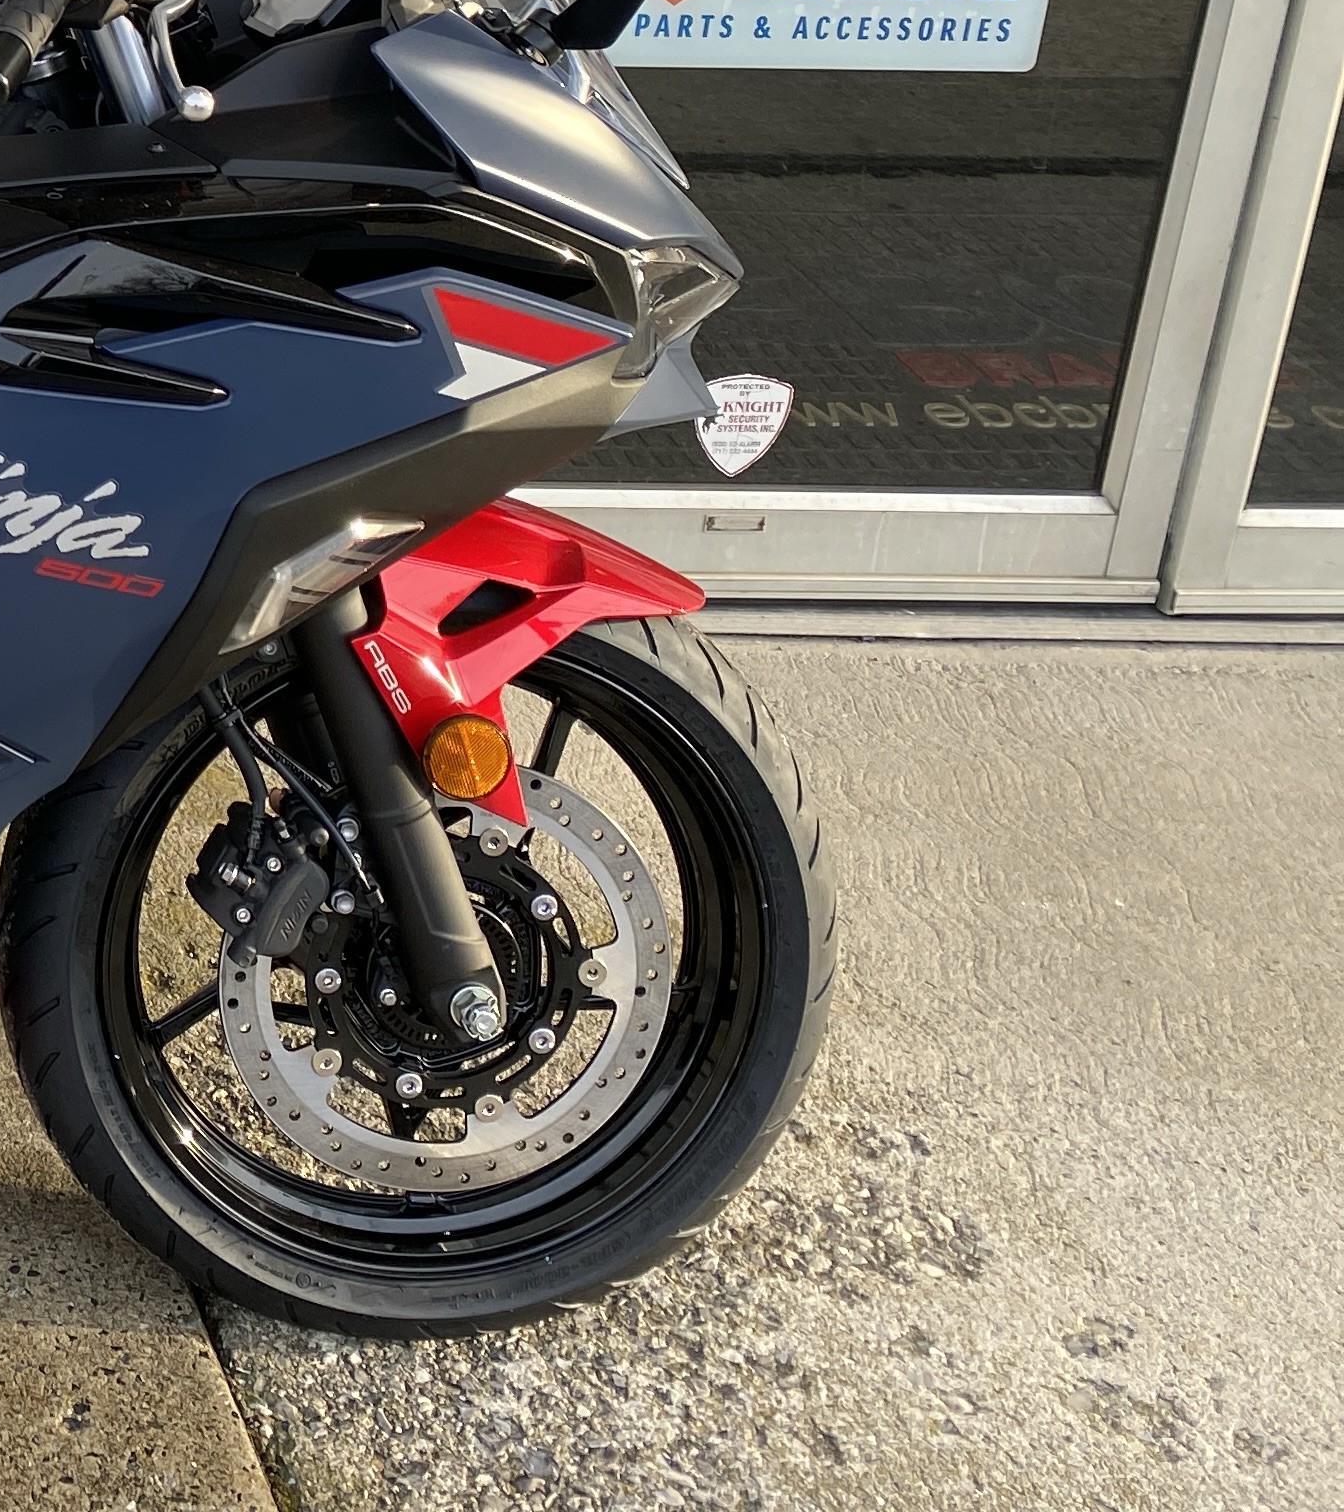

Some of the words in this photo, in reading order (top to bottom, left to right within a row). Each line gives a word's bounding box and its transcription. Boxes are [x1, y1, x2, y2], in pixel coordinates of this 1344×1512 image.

[634, 14, 735, 38] PARTS
[754, 16, 772, 39] &
[792, 16, 1012, 42] ACCESSORIES
[723, 401, 785, 413] KNIGHT
[728, 415, 771, 424] SECURITY
[33, 556, 165, 598] 500
[363, 639, 412, 715] ABS
